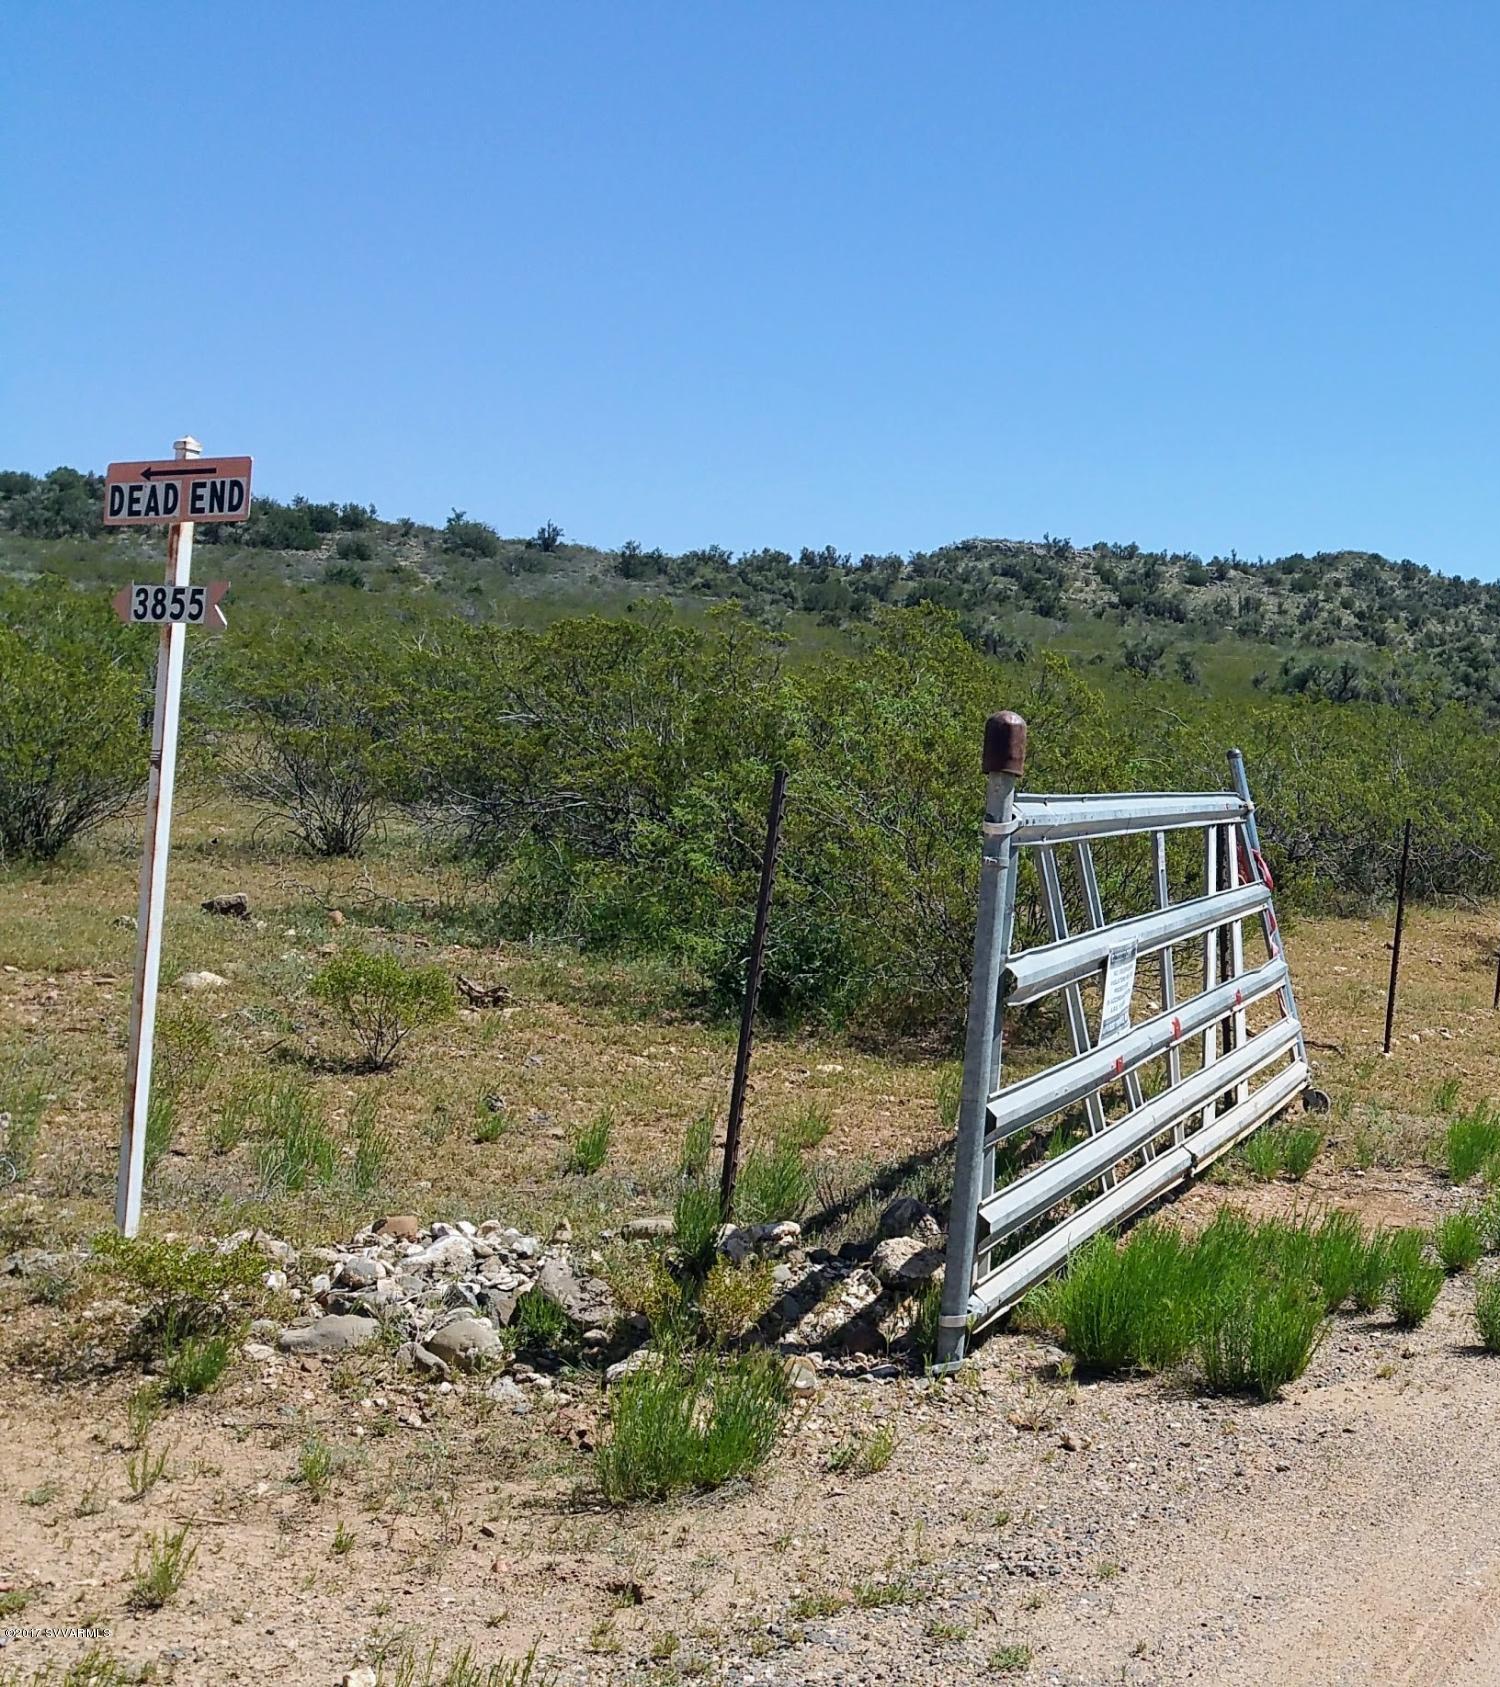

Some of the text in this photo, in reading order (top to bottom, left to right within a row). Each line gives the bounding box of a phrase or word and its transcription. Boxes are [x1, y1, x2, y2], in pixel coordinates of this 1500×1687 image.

[109, 479, 244, 517] DEAD END
[133, 587, 204, 621] 3855
